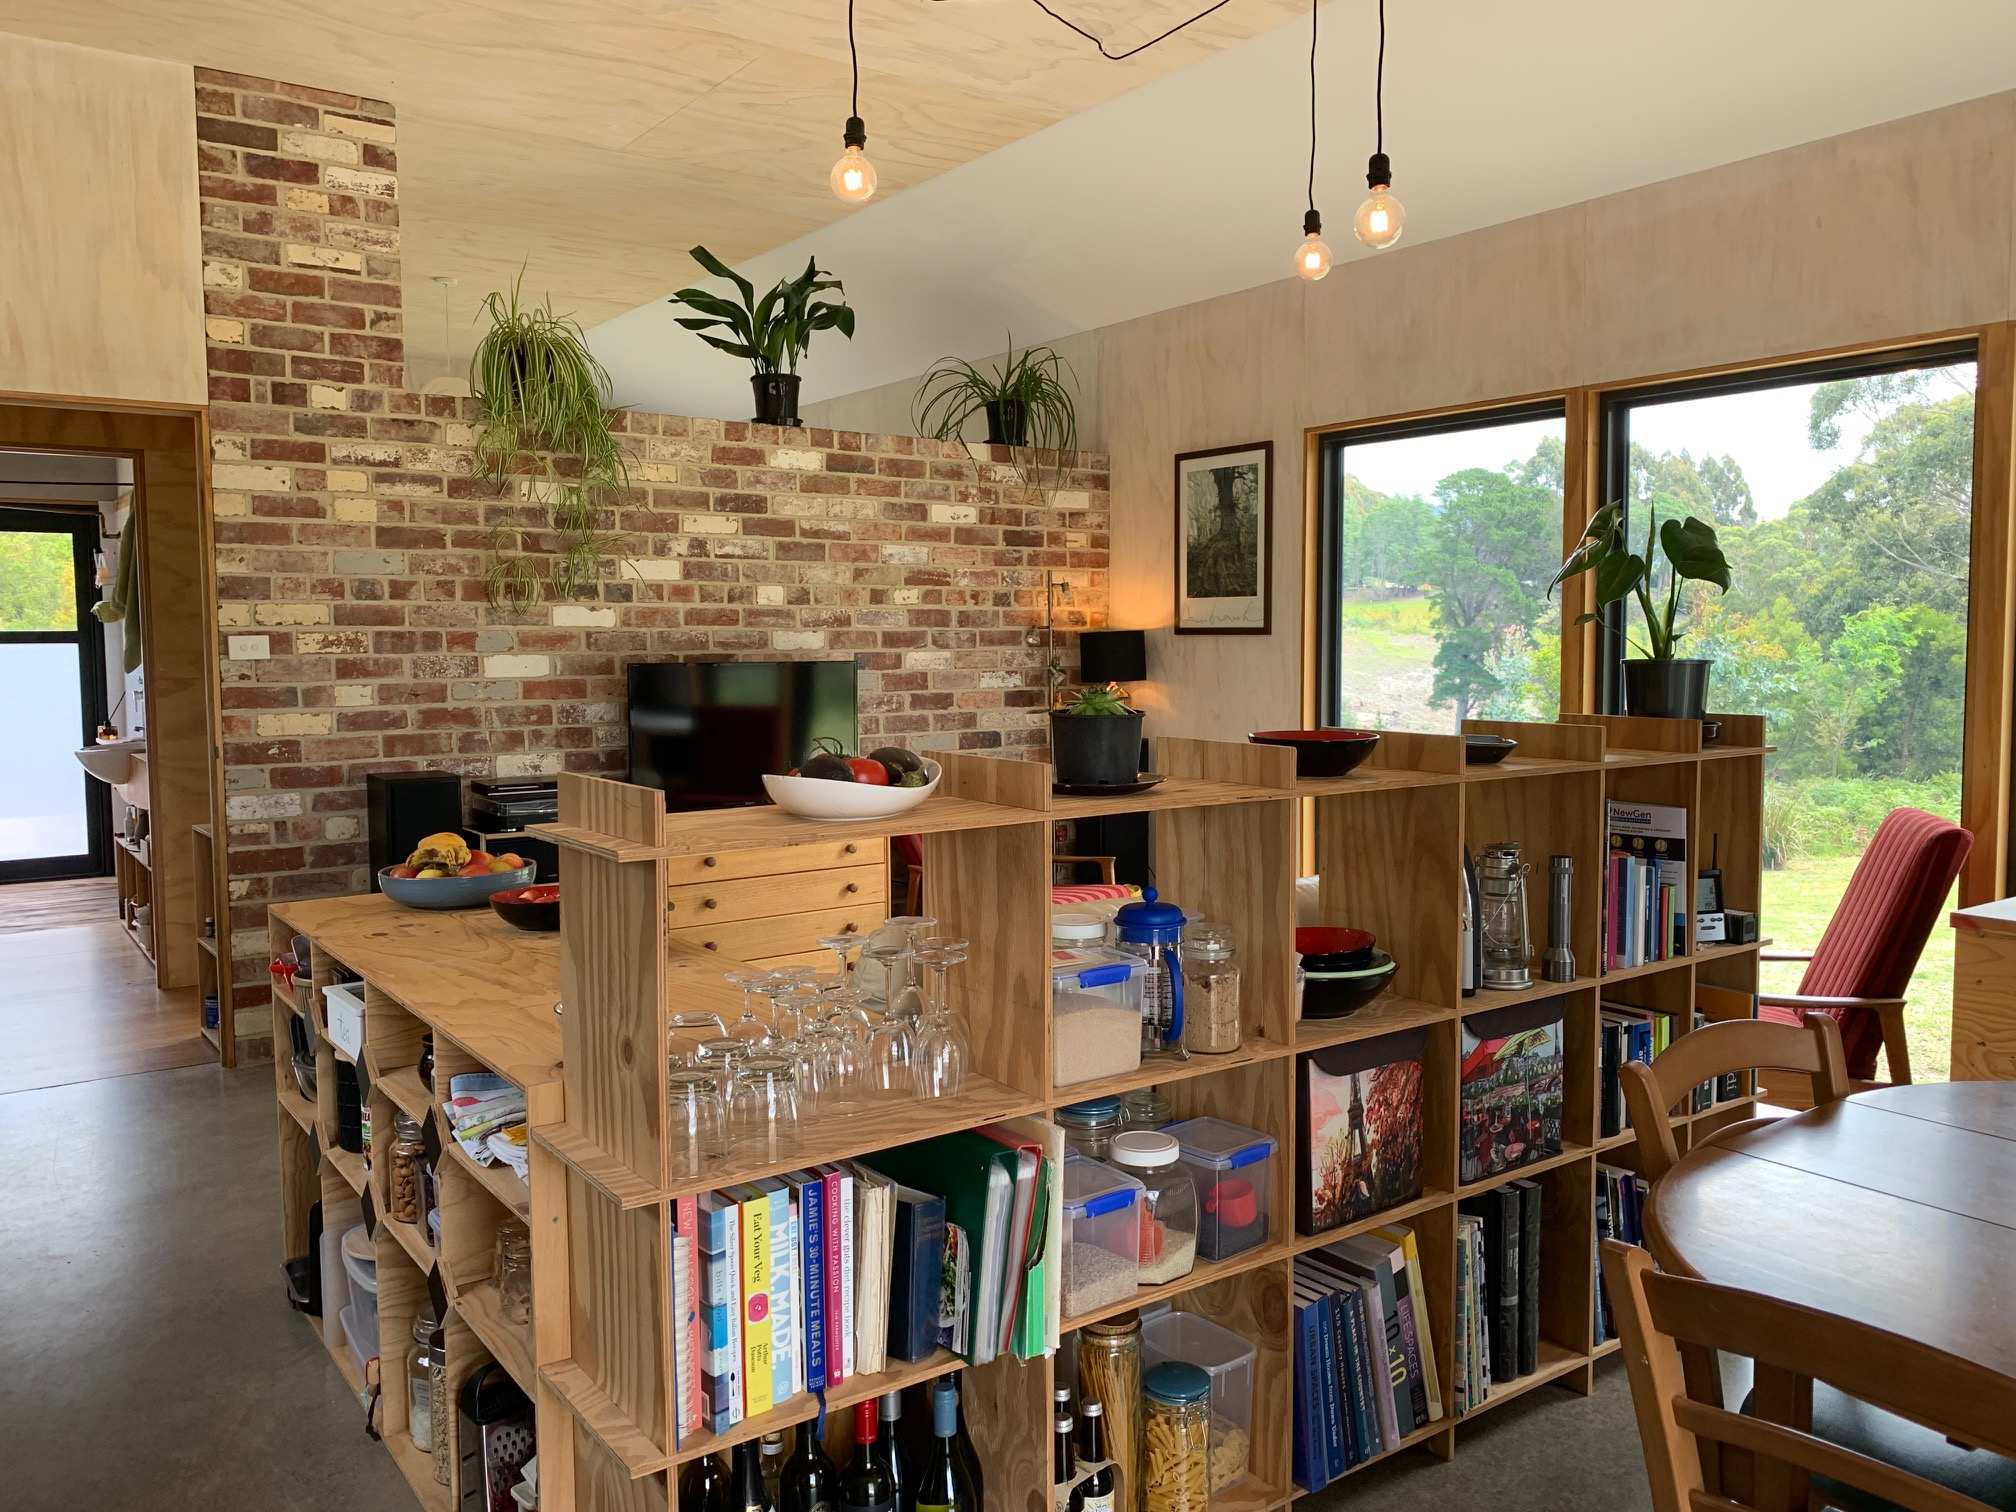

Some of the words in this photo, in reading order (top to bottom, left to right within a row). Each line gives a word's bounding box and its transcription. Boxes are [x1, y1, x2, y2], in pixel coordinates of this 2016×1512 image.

[1613, 808, 1652, 818] NewGen
[682, 1201, 693, 1231] NEW
[753, 1213, 762, 1231] Eat
[808, 1189, 819, 1244] JAMIE'S
[753, 1231, 763, 1259] Your
[753, 1260, 763, 1284] Veg
[809, 1246, 820, 1317] 30-MINUTE
[832, 1255, 840, 1293] PASSION
[1400, 1304, 1412, 1332] LIFE
[810, 1320, 822, 1367] MEALS
[1404, 1332, 1419, 1379] SPACES
